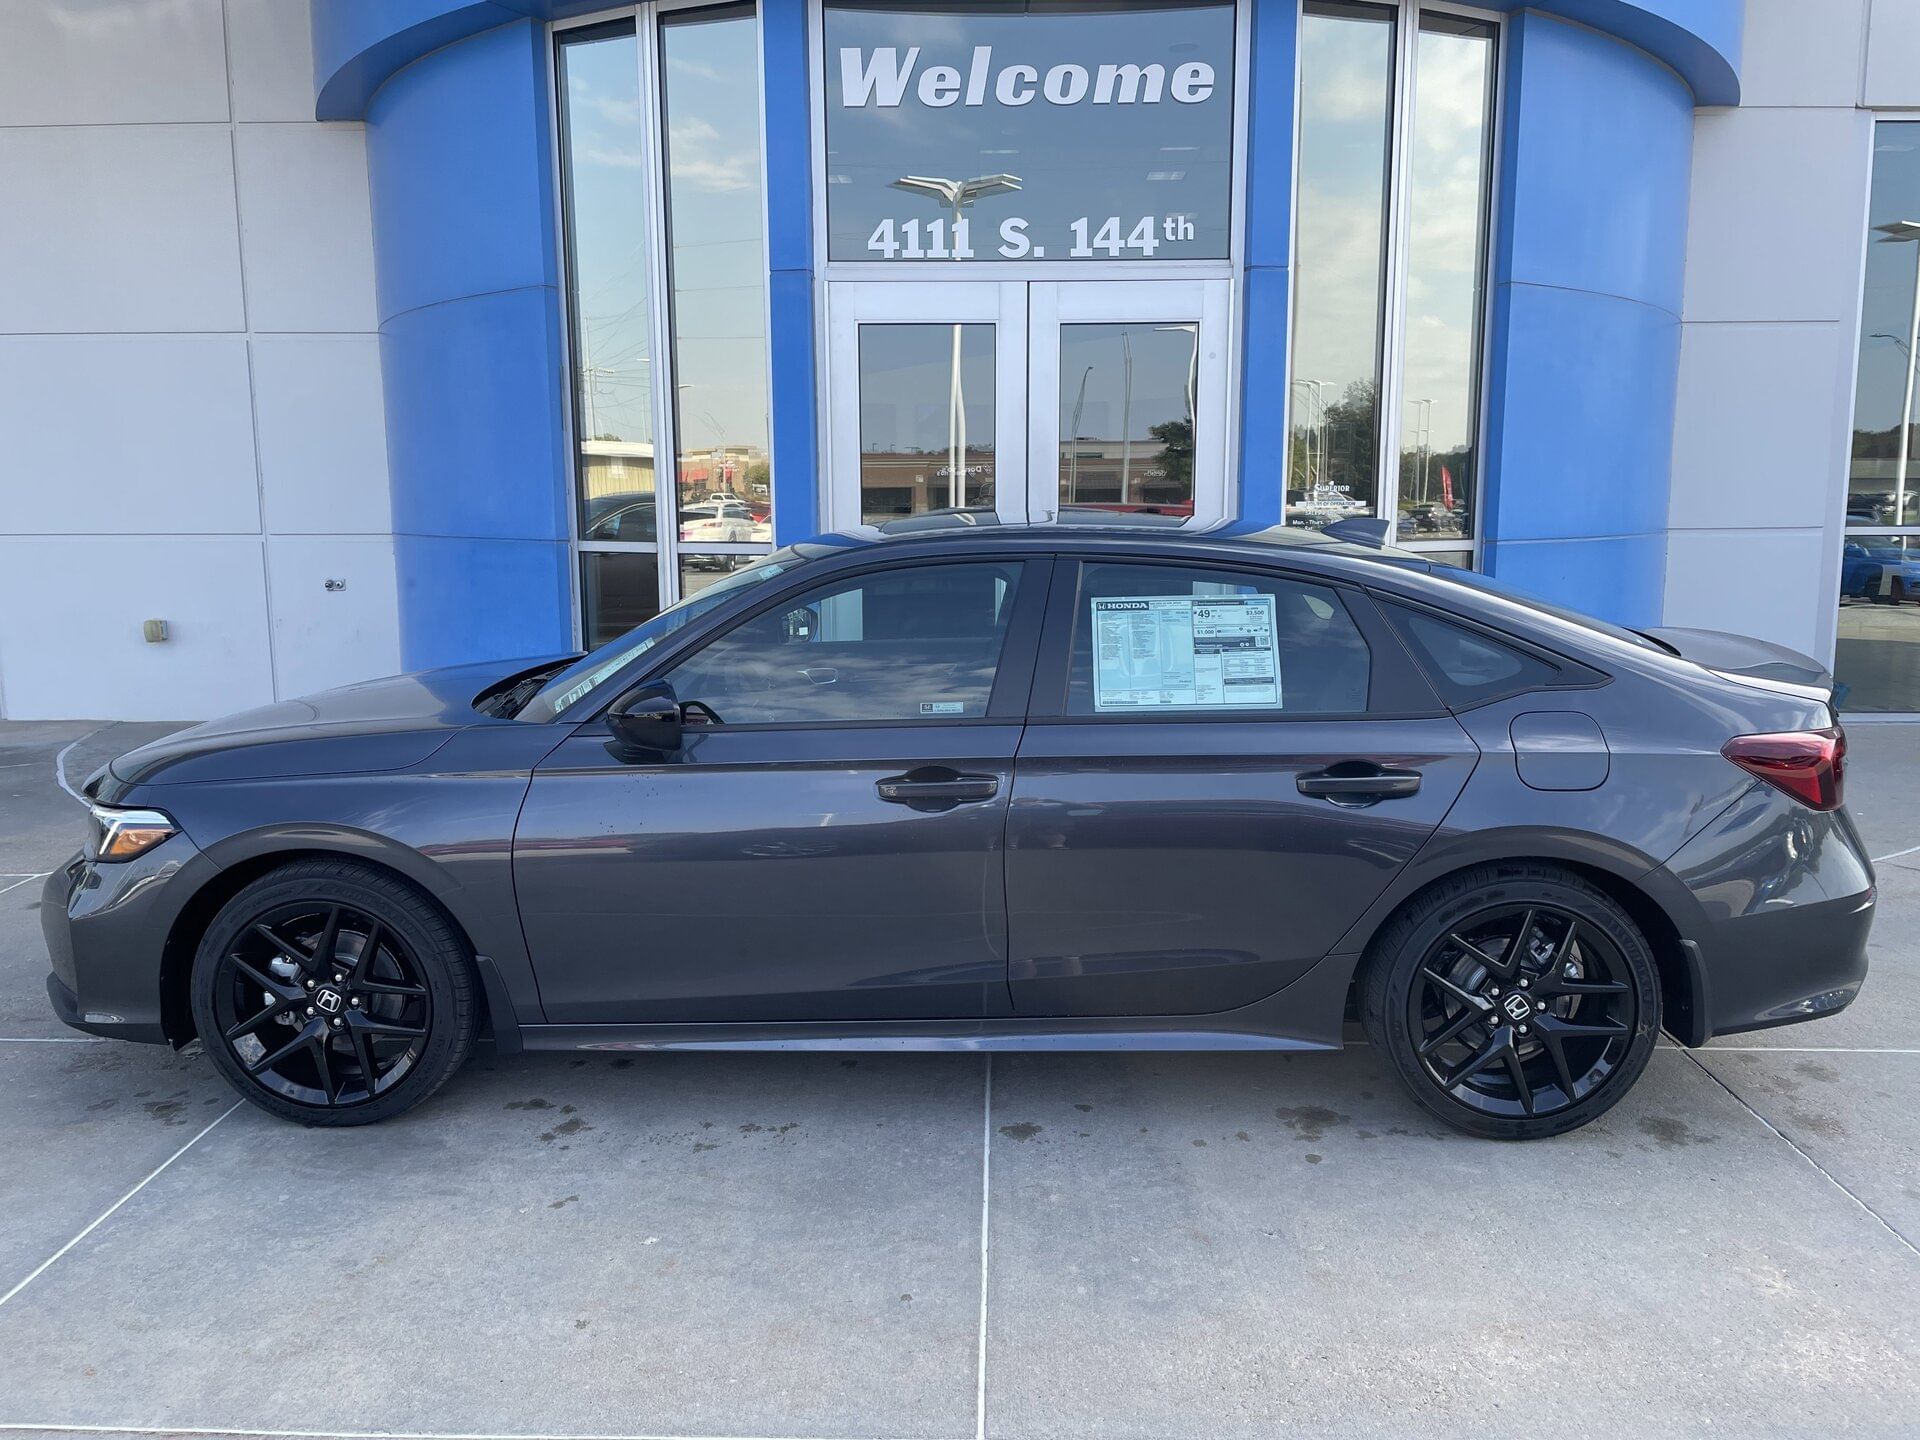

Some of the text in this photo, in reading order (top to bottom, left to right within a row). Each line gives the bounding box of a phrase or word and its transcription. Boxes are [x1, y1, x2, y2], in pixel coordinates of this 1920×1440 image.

[840, 45, 1215, 107] Welcome
[867, 215, 1195, 260] 4111 S. 144th
[1107, 602, 1148, 610] HONDA
[1198, 609, 1210, 618] 49
